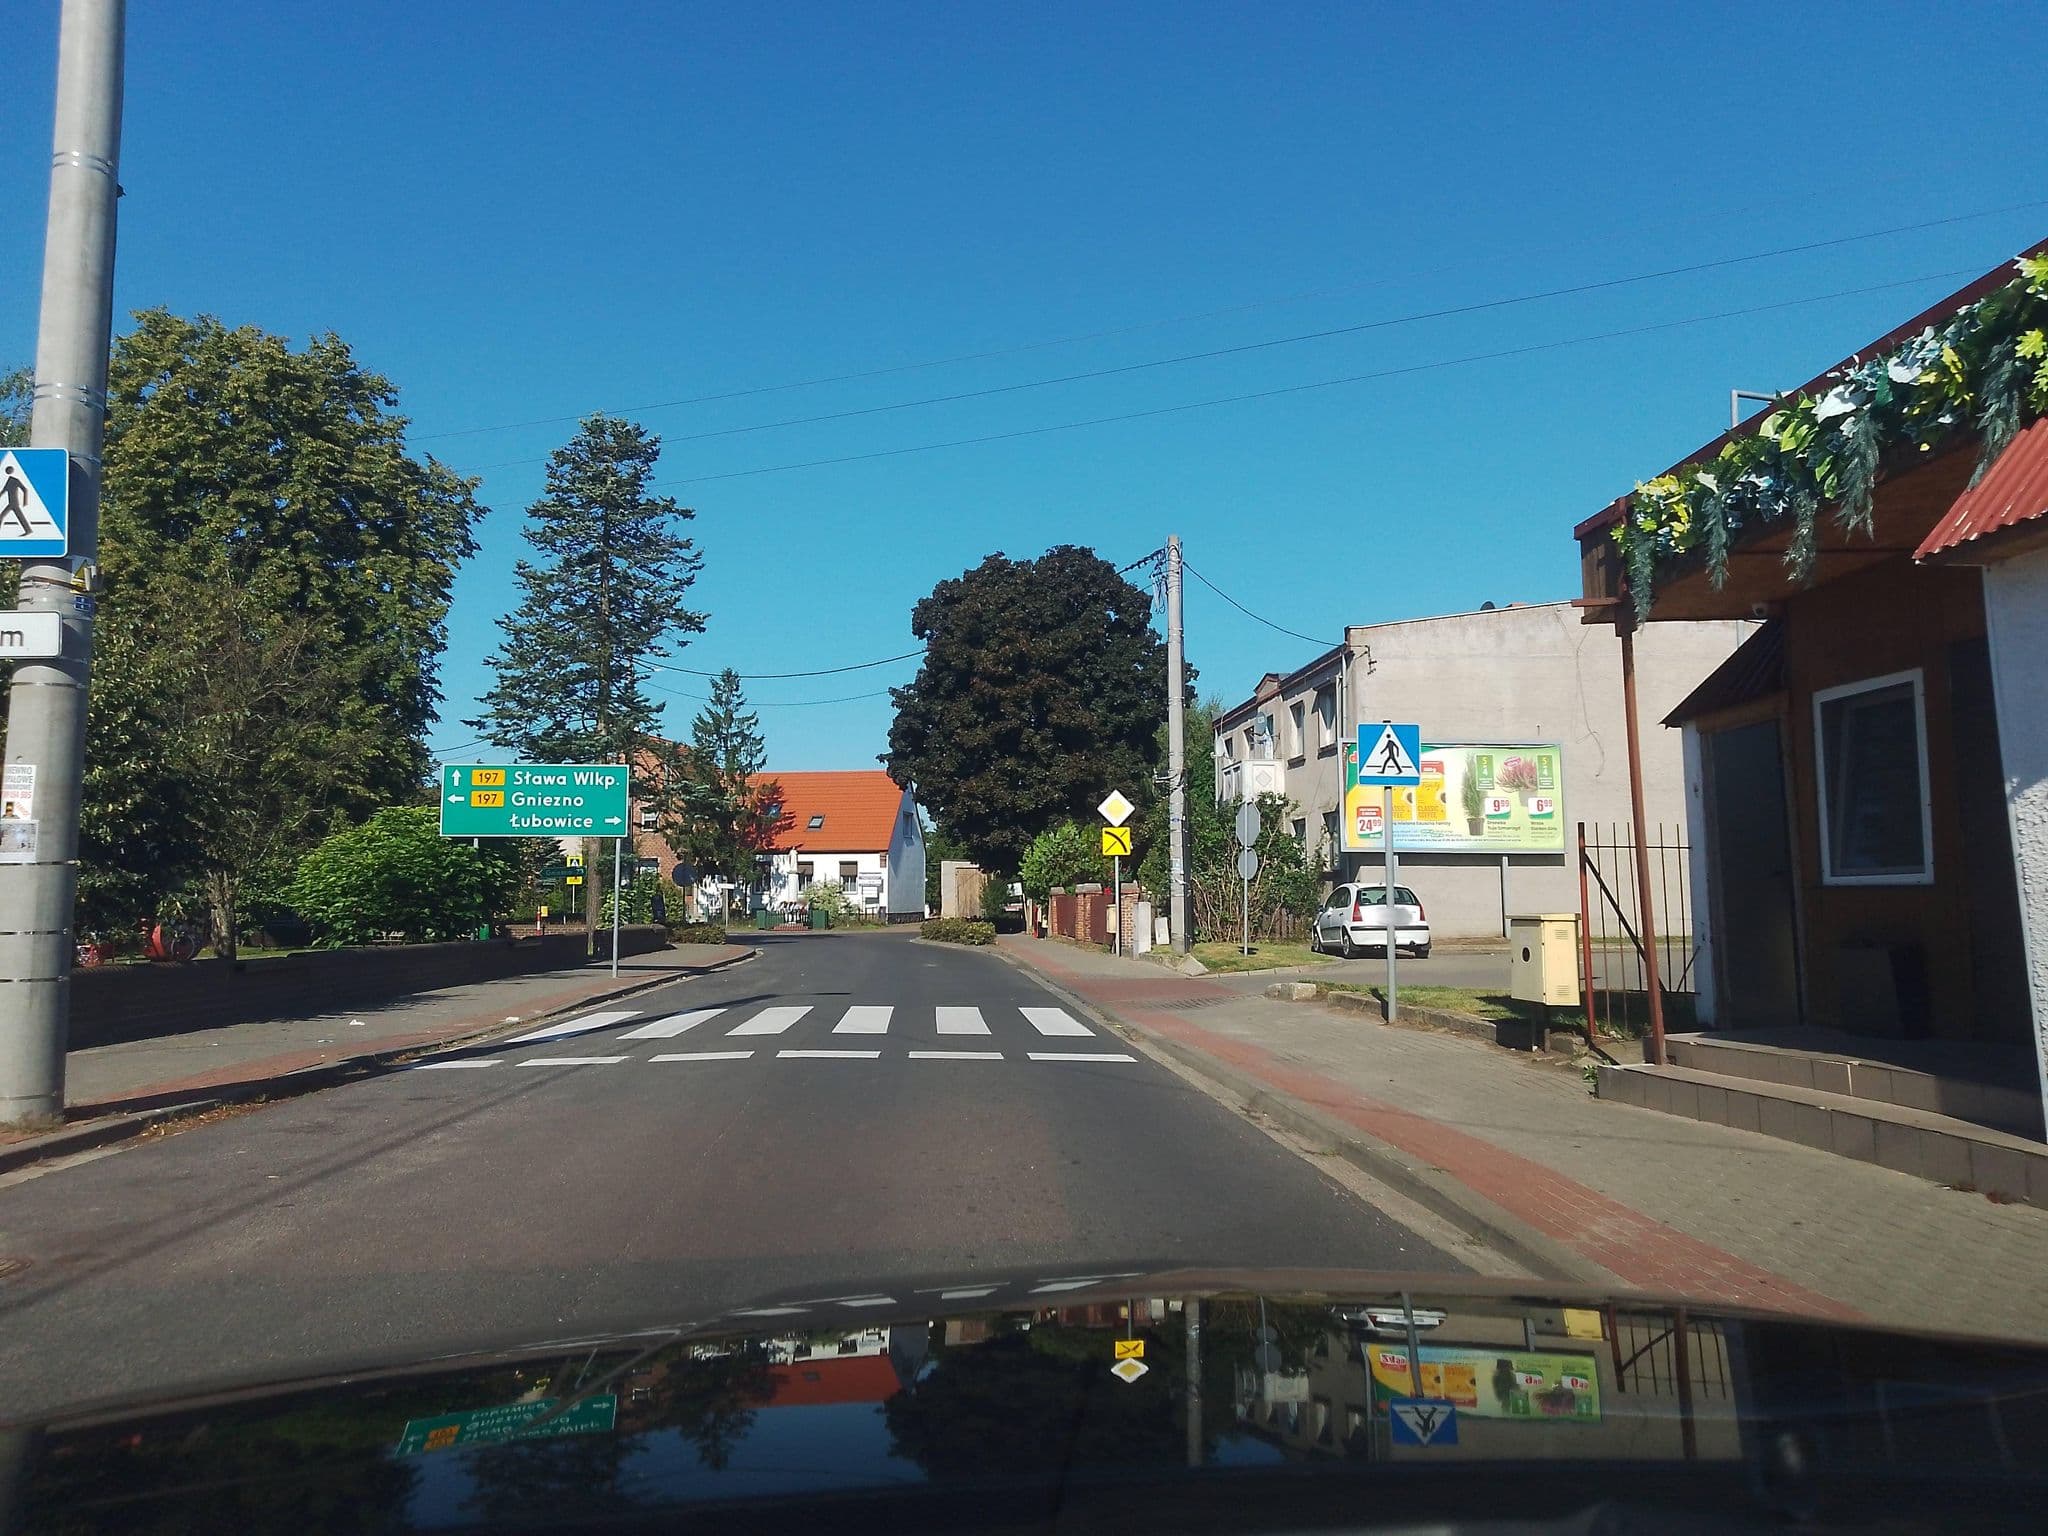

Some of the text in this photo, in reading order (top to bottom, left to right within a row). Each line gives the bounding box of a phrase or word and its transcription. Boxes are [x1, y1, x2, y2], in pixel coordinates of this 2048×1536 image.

[0, 630, 24, 647] m
[478, 771, 620, 790] 197 Sława Wlkp.
[477, 792, 584, 807] 197 Gniezno
[509, 813, 594, 828] Łubowice
